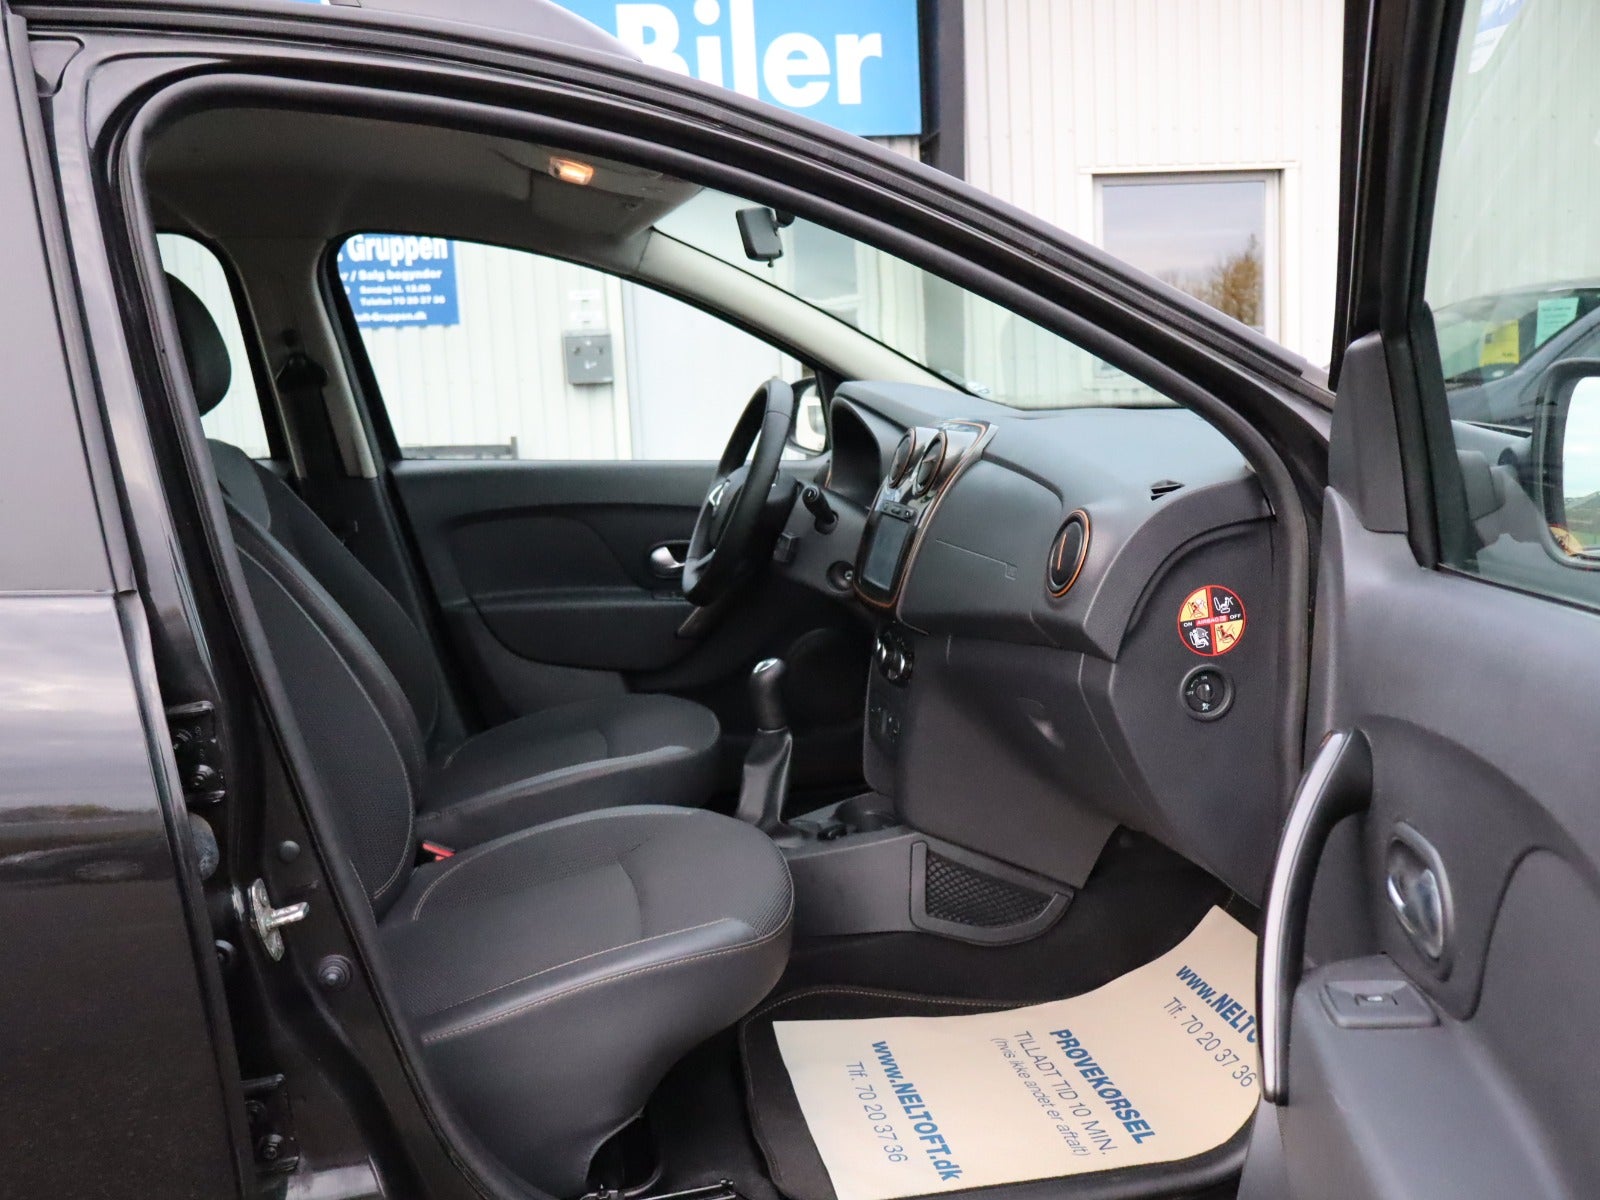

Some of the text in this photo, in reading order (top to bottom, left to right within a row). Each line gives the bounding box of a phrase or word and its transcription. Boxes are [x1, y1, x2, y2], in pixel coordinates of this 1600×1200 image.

[616, 0, 882, 107] Biler
[346, 234, 448, 267] Gruppen
[1009, 1060, 1030, 1078] ikke
[1024, 1080, 1056, 1107] andet
[1047, 1109, 1064, 1121] er
[1014, 1030, 1118, 1155] TILLADT TID 10 MIN.
[1164, 997, 1257, 1087] Tlf. 70 20 37 36
[846, 1061, 908, 1162] Tlf. 70 20 37 36
[872, 1040, 963, 1181] www.NELTOFT.dk
